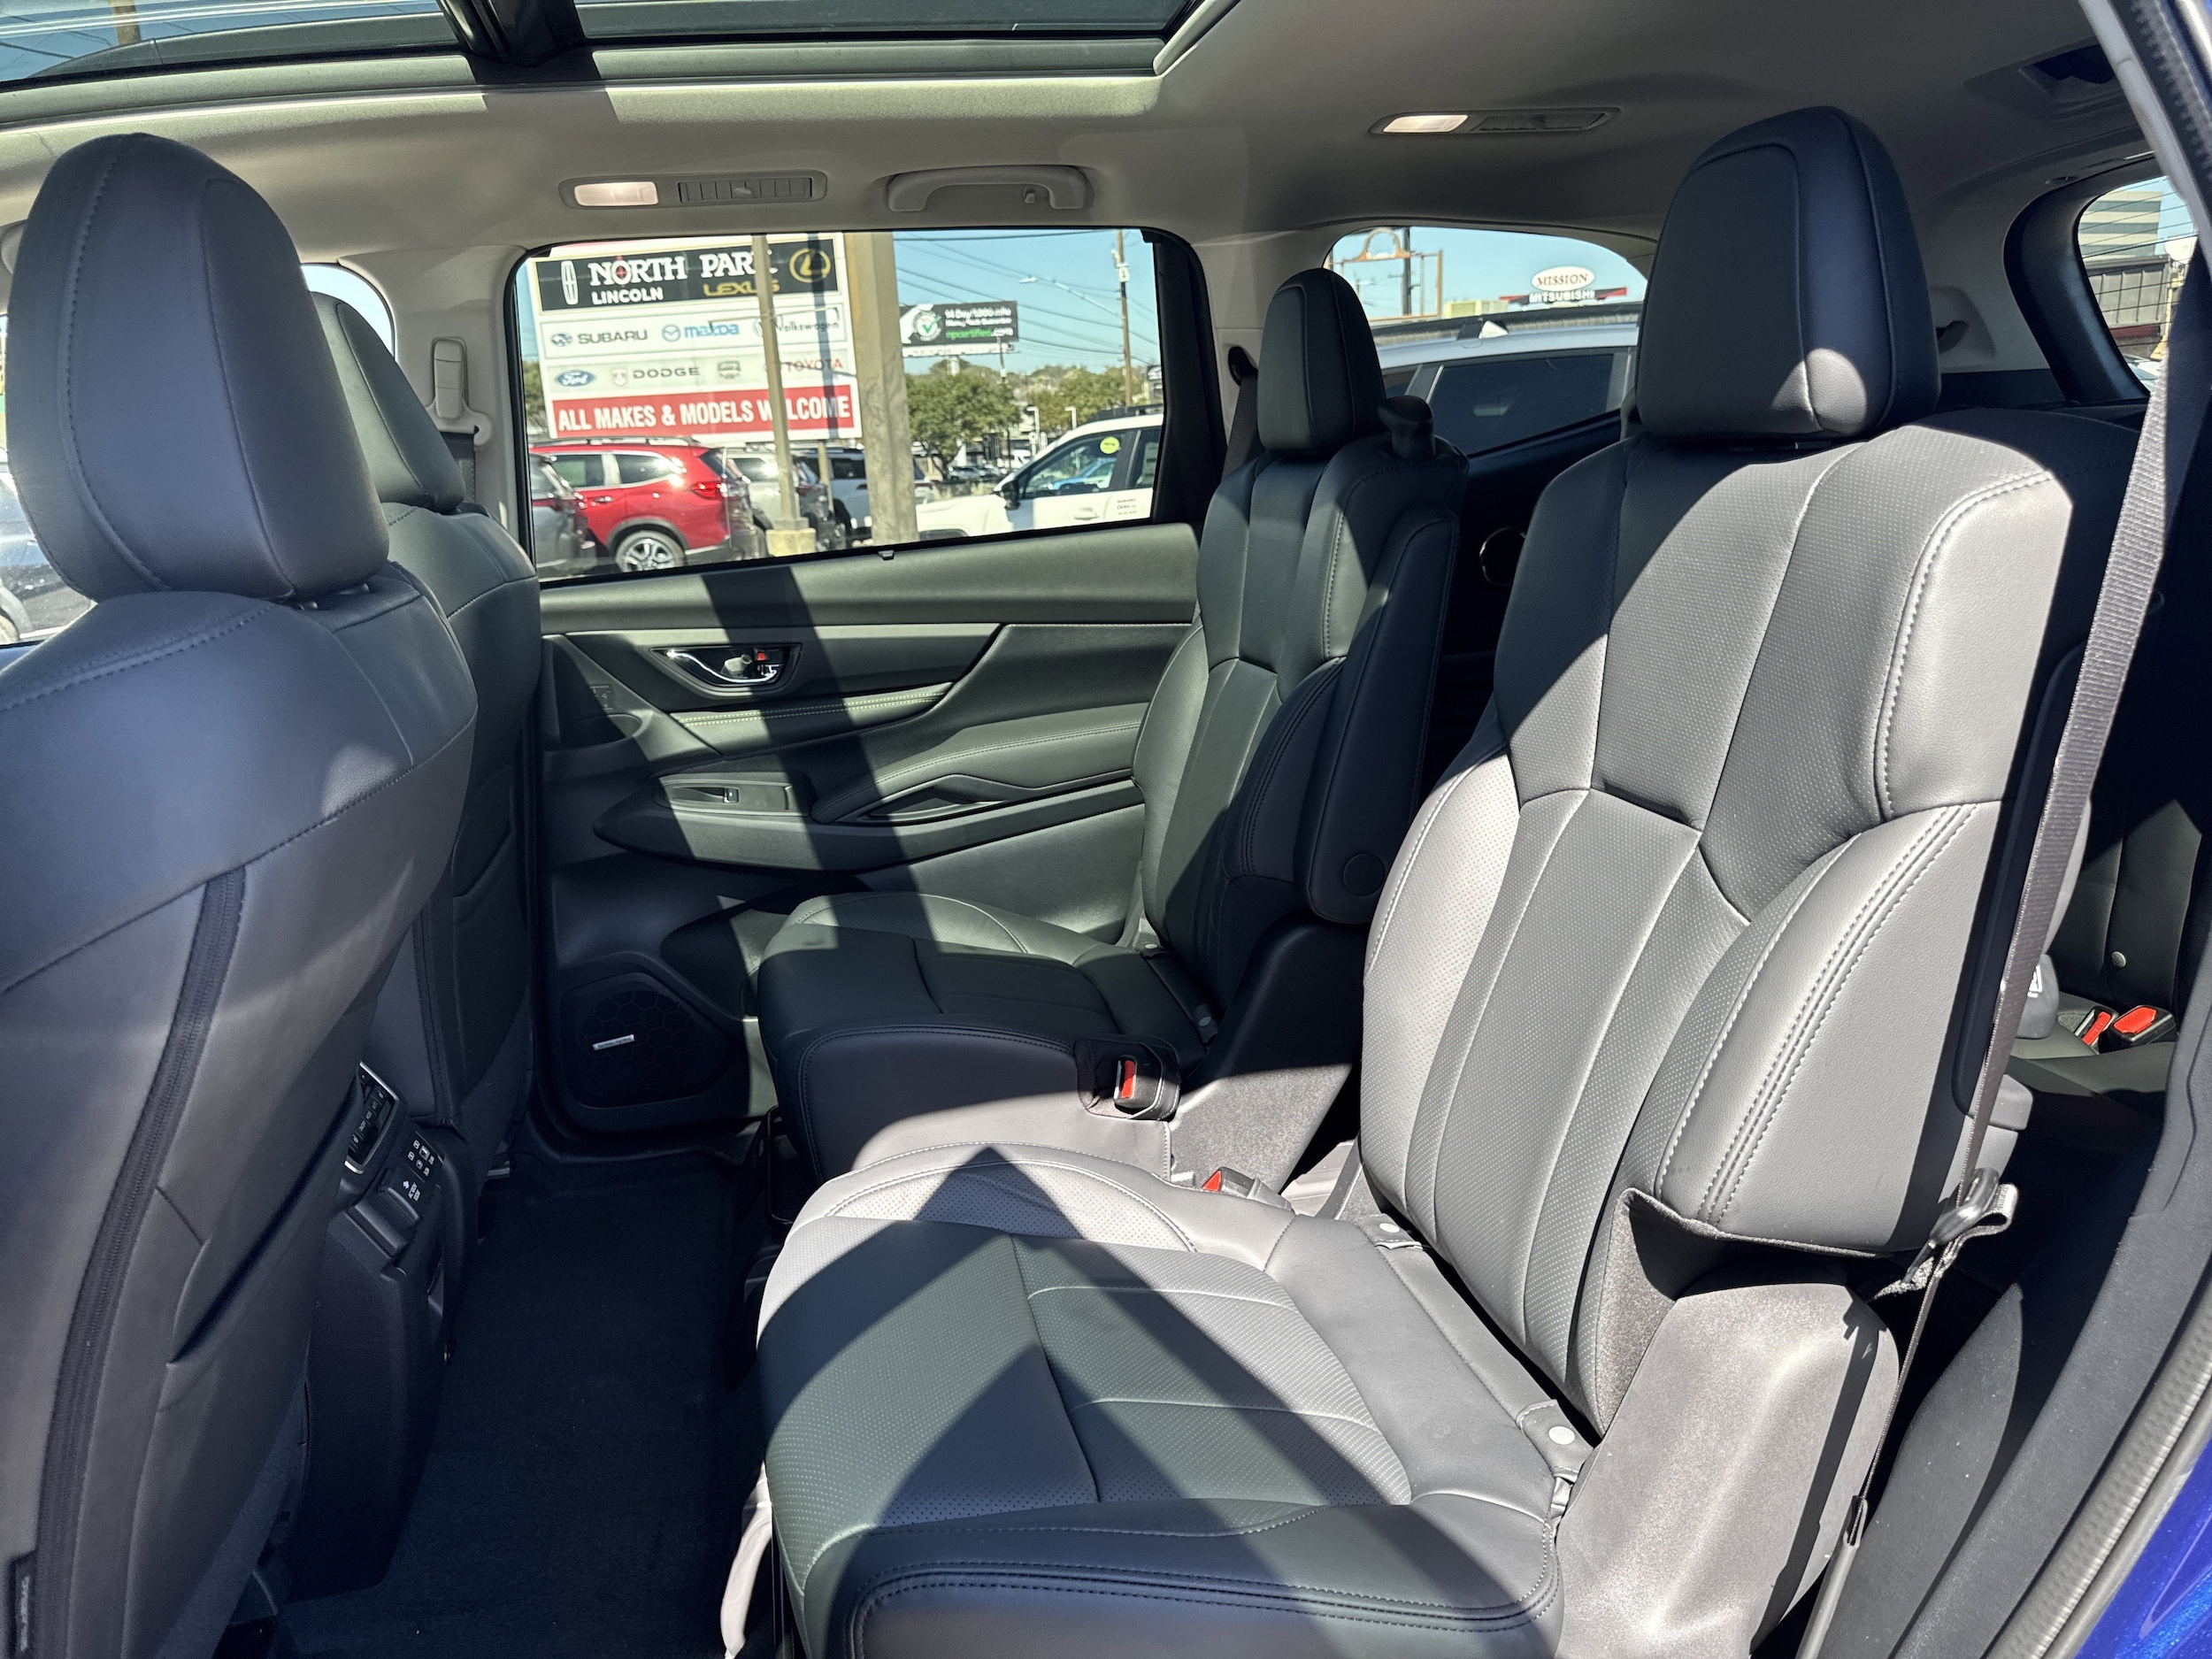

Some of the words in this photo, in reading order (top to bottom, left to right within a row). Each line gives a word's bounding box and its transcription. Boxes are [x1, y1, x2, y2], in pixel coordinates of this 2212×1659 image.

[588, 256, 687, 286] NORTH
[698, 249, 779, 279] PAR
[1537, 273, 1588, 288] MISSION
[591, 287, 664, 305] LINCOLN
[1529, 289, 1595, 303] MITSUBISHI
[577, 329, 649, 345] SUBARU
[633, 367, 701, 380] DODGE
[787, 358, 843, 373] TOYOTA
[560, 371, 590, 387] Ford
[558, 408, 593, 432] ALL
[594, 404, 657, 430] MAKES
[661, 404, 677, 426] &
[680, 399, 755, 426] MODELS
[756, 395, 851, 422] WLCOME
